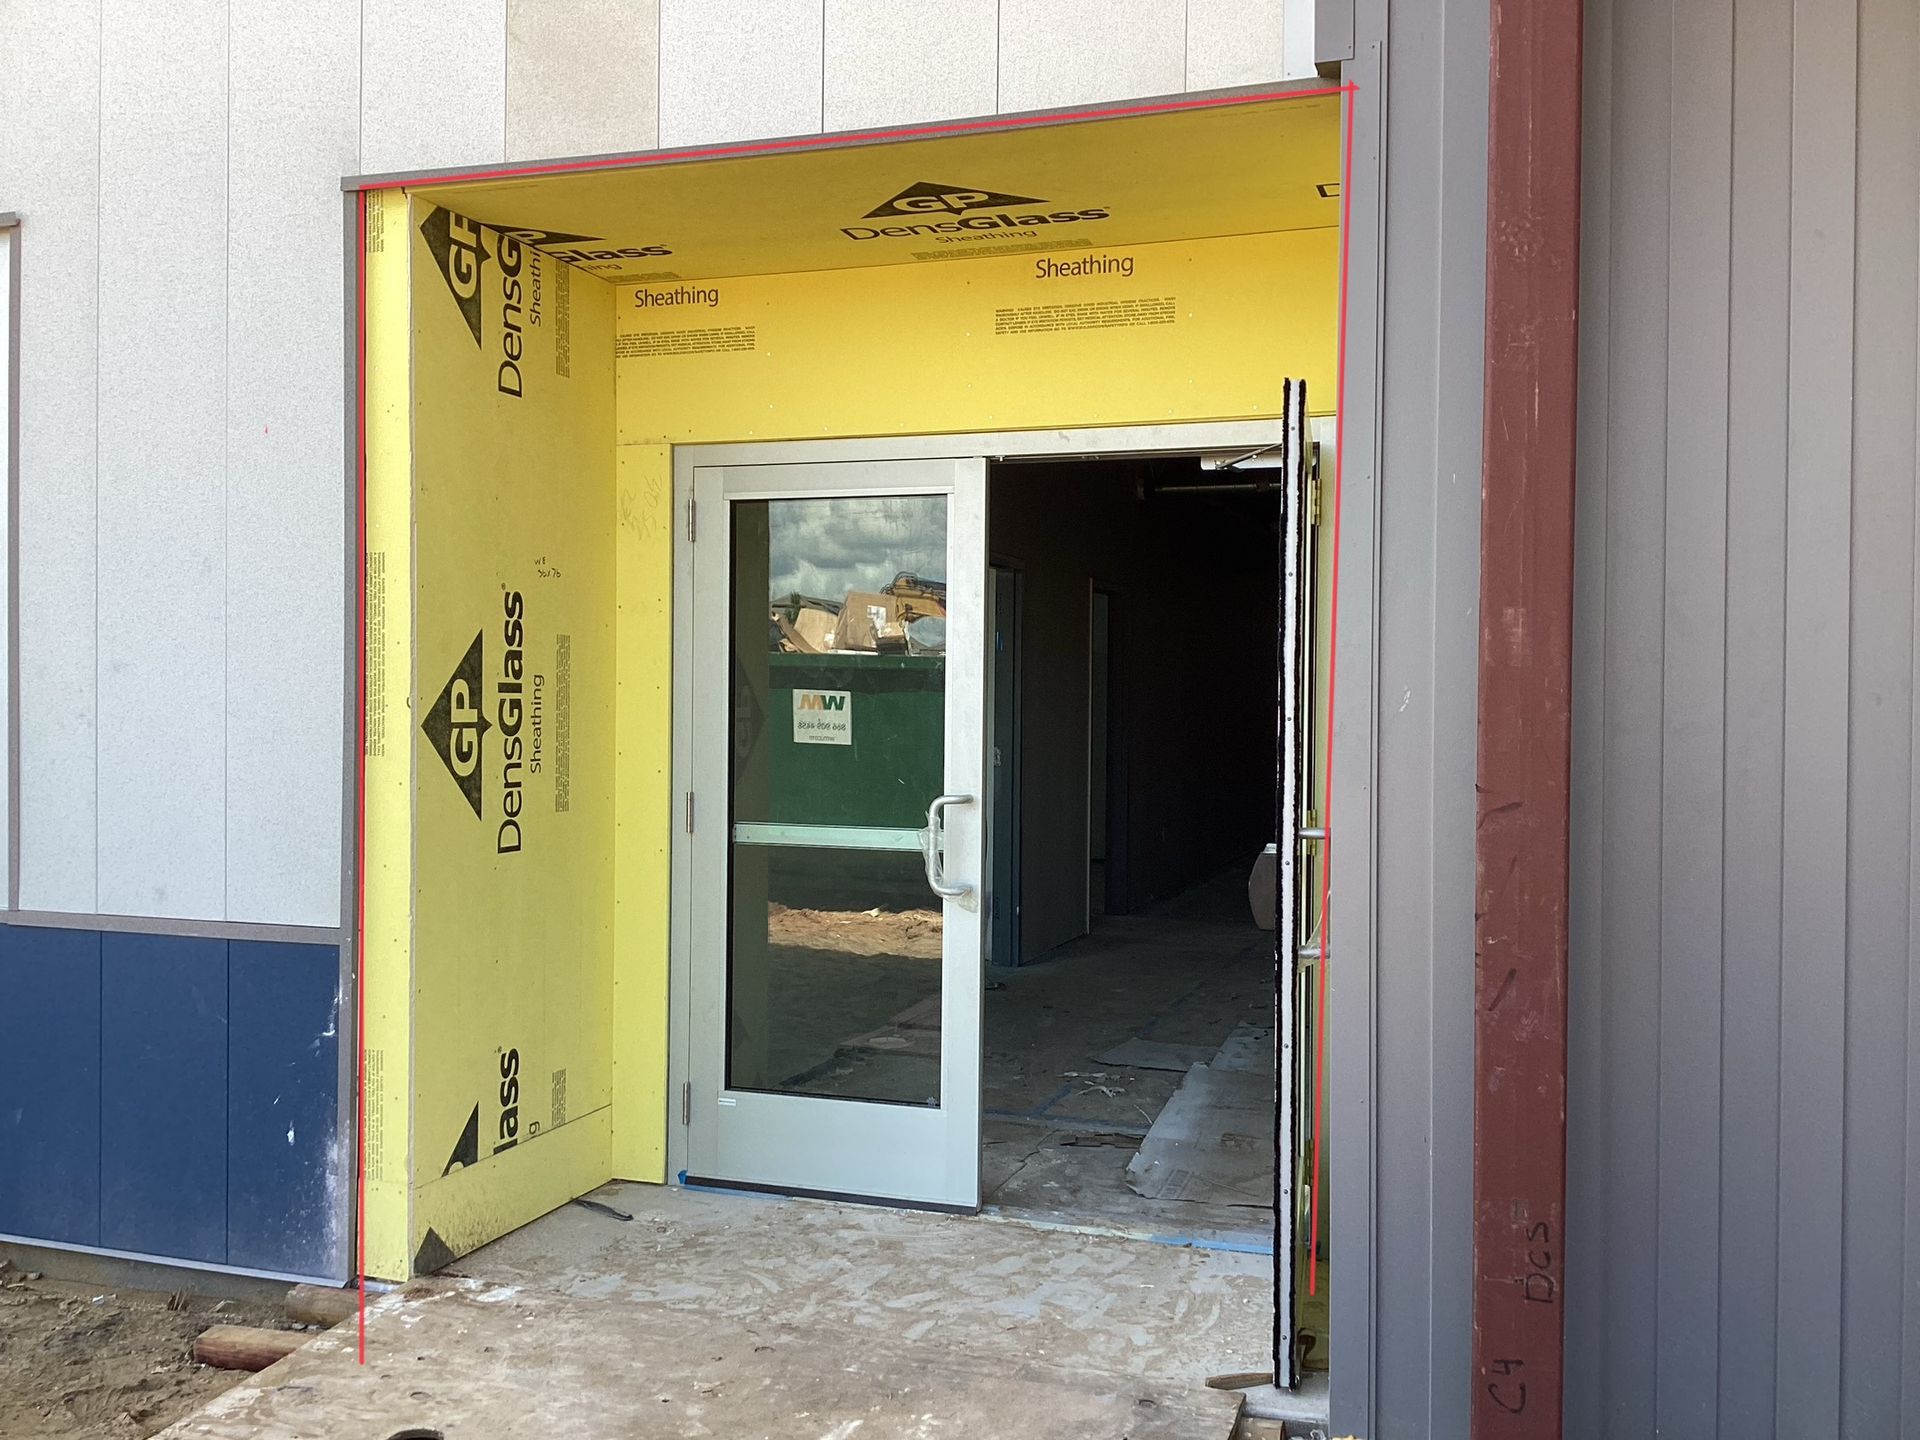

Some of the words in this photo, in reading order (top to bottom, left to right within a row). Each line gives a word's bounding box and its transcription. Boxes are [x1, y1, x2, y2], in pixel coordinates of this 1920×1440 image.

[893, 191, 989, 212] GP
[935, 228, 1038, 244] Sheathing
[1036, 254, 1135, 279] Sheathing
[634, 286, 719, 308] Sheathing
[449, 678, 478, 777] GP
[530, 674, 545, 774] Sheathing
